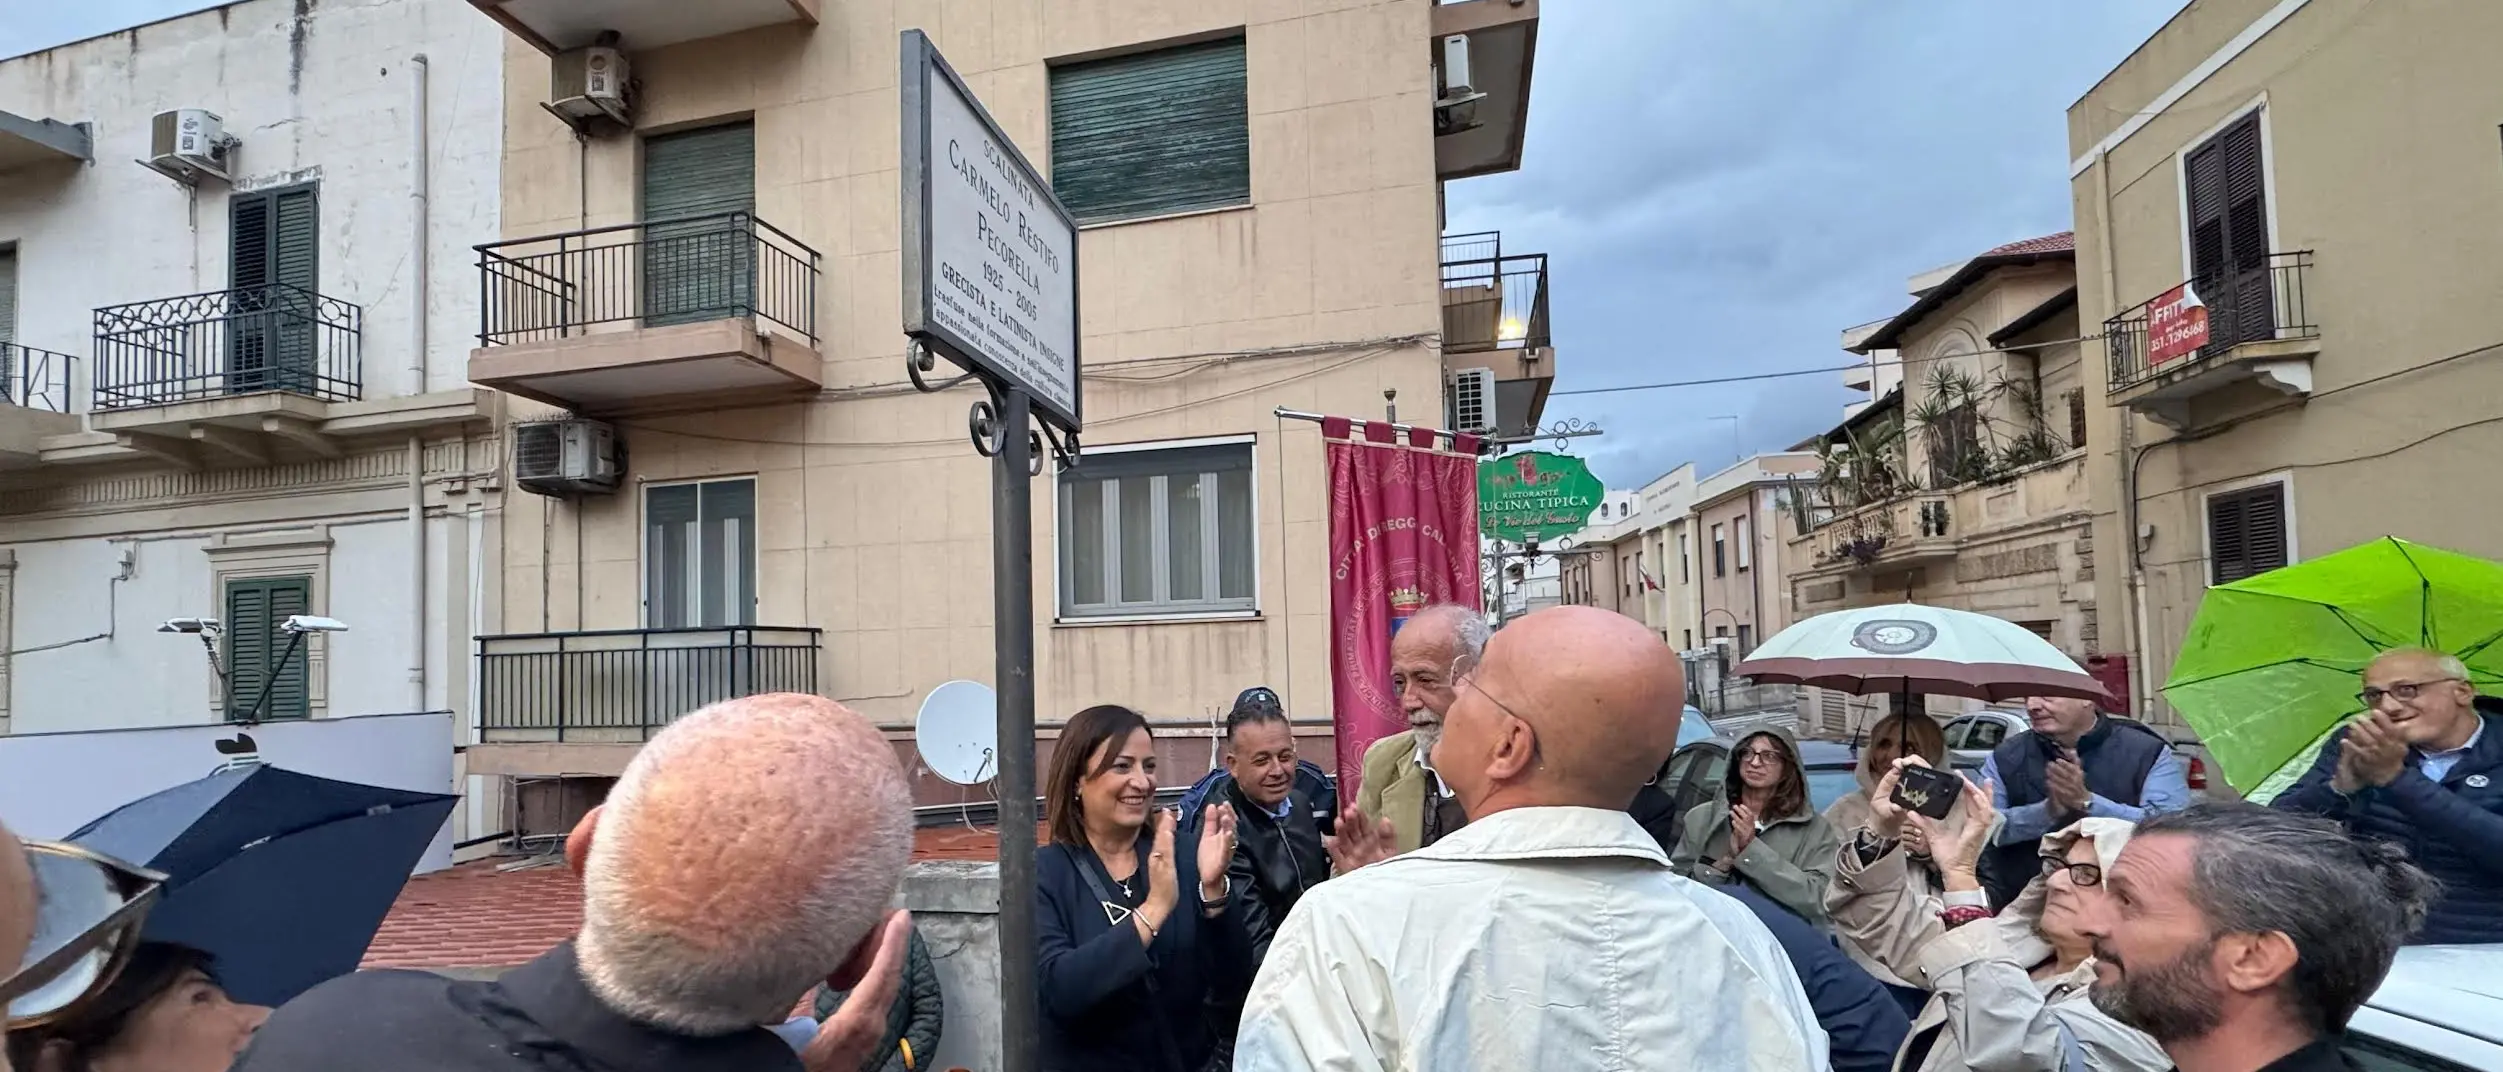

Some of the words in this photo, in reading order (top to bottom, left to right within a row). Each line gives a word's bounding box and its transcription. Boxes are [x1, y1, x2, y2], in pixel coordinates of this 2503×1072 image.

[949, 138, 1010, 223] CARMELO
[1018, 209, 1059, 274] RESTIFO
[984, 139, 1034, 211] SCALINATA
[977, 210, 1040, 295] PECORELLA
[934, 284, 965, 317] trasfuse
[968, 312, 984, 332] nella
[942, 261, 986, 311] GRECISTA
[990, 300, 996, 317] E
[998, 307, 1038, 351] LATINISTA
[1039, 340, 1065, 373] INSIGNE
[983, 261, 1003, 292] 1925
[1016, 290, 1037, 321] 2005
[1503, 488, 1559, 499] RISTORANTE
[1537, 496, 1589, 508] TIPICA
